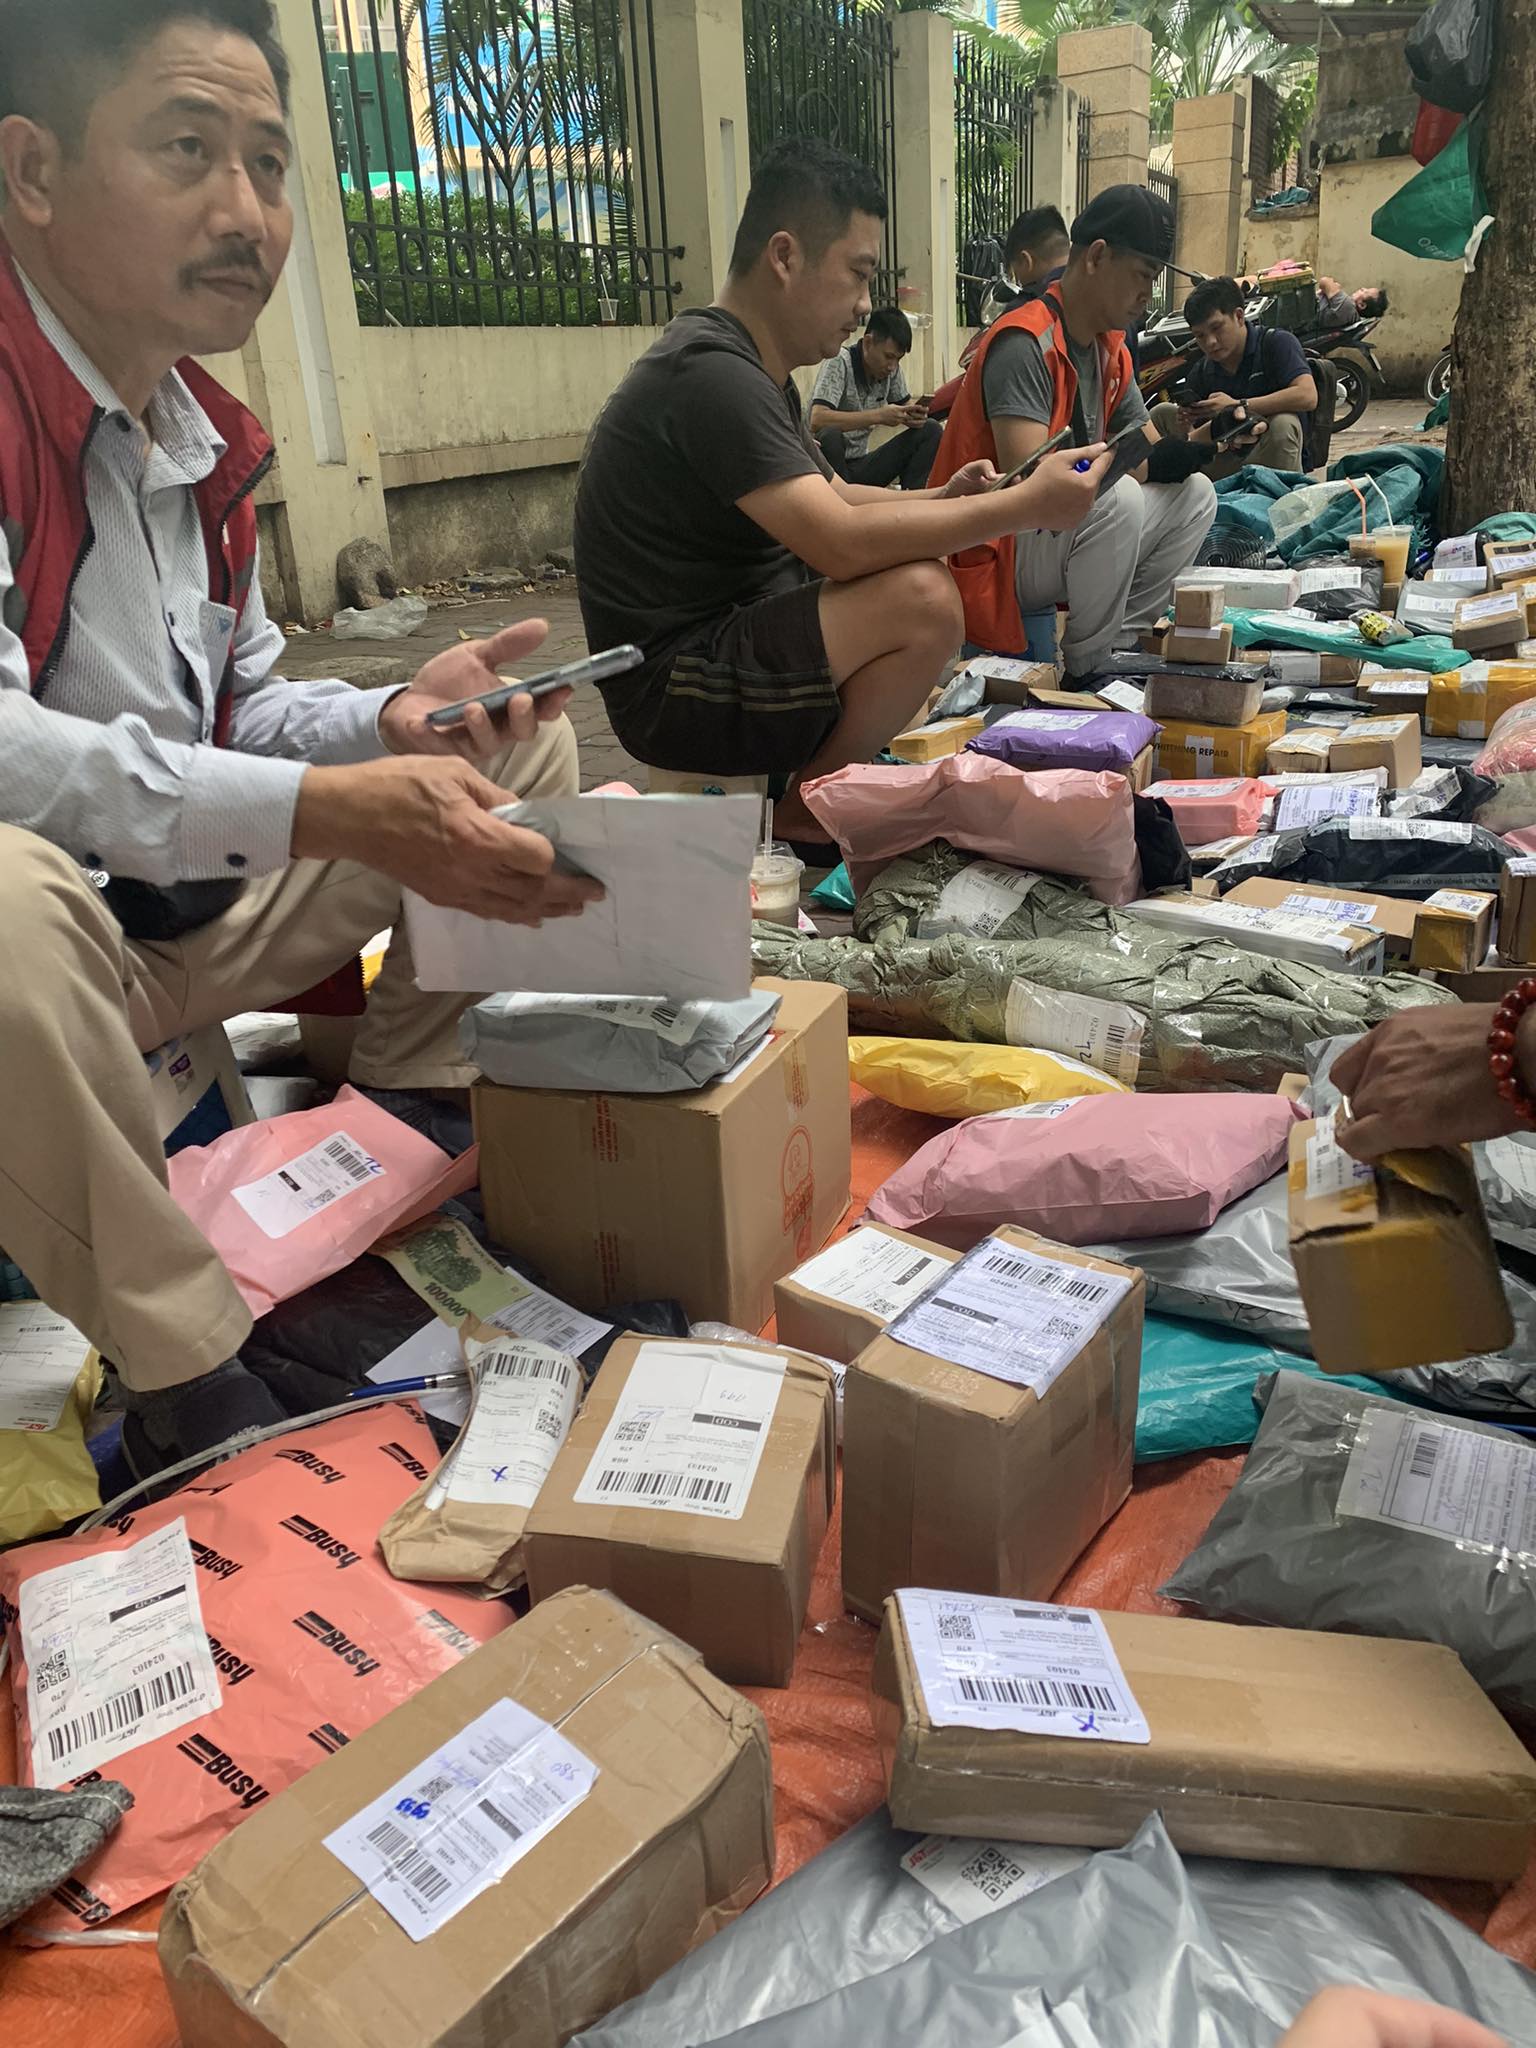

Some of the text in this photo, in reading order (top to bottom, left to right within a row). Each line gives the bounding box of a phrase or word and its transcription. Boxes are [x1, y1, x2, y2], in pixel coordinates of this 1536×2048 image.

[1199, 747, 1229, 758] REPAIR
[424, 1281, 467, 1318] 100000
[952, 1304, 976, 1317] COD
[715, 1416, 739, 1426] COD
[402, 1458, 428, 1482] BU
[133, 1594, 163, 1611] COD
[130, 1652, 166, 1676] 024103
